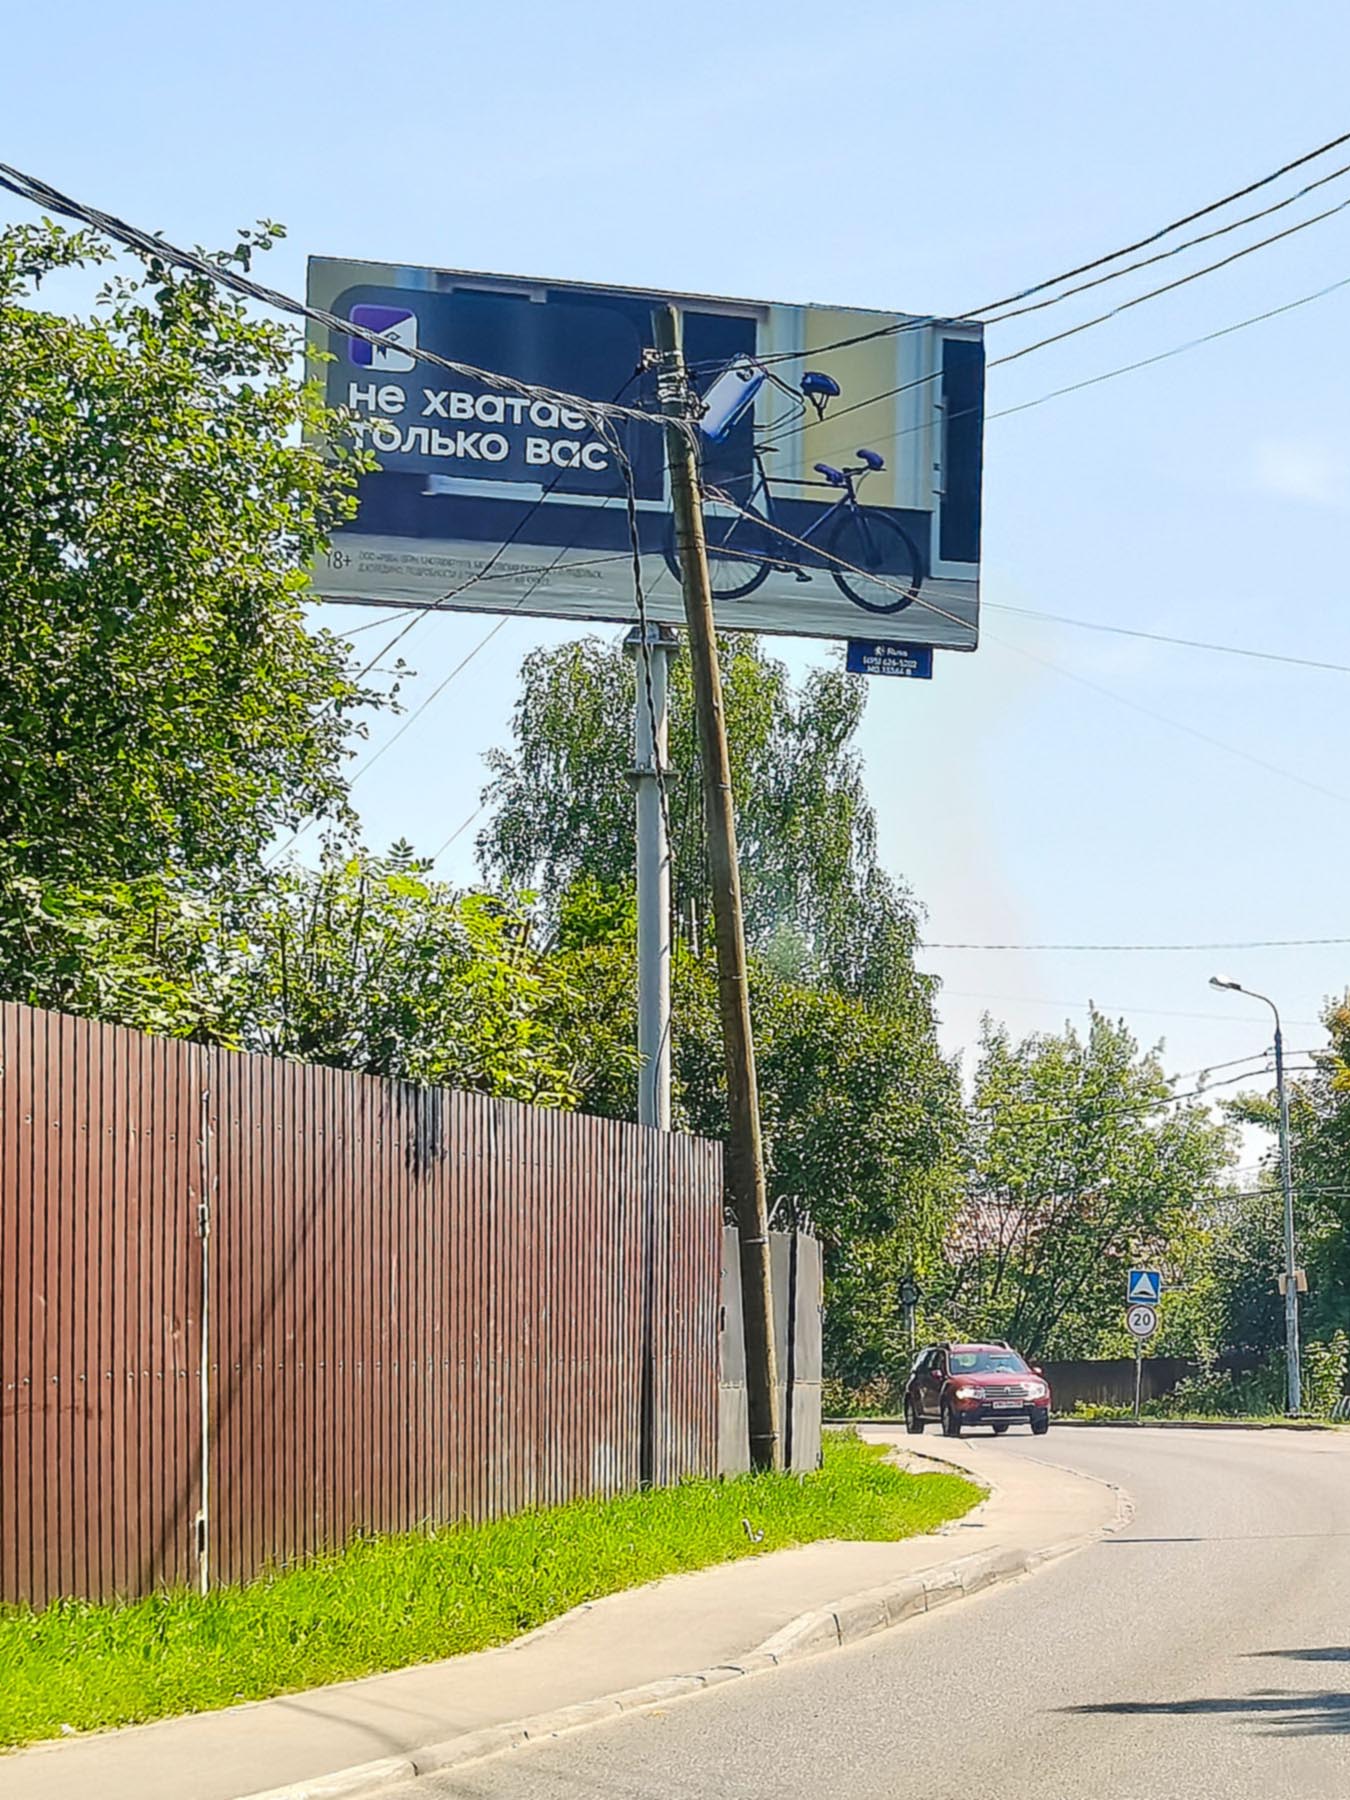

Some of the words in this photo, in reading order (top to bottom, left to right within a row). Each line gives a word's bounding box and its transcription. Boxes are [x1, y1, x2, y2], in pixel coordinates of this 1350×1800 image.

[349, 382, 406, 414] не
[348, 420, 509, 462] только
[525, 437, 609, 470] вас
[327, 550, 352, 570] 18+
[1133, 1312, 1152, 1327] 20
